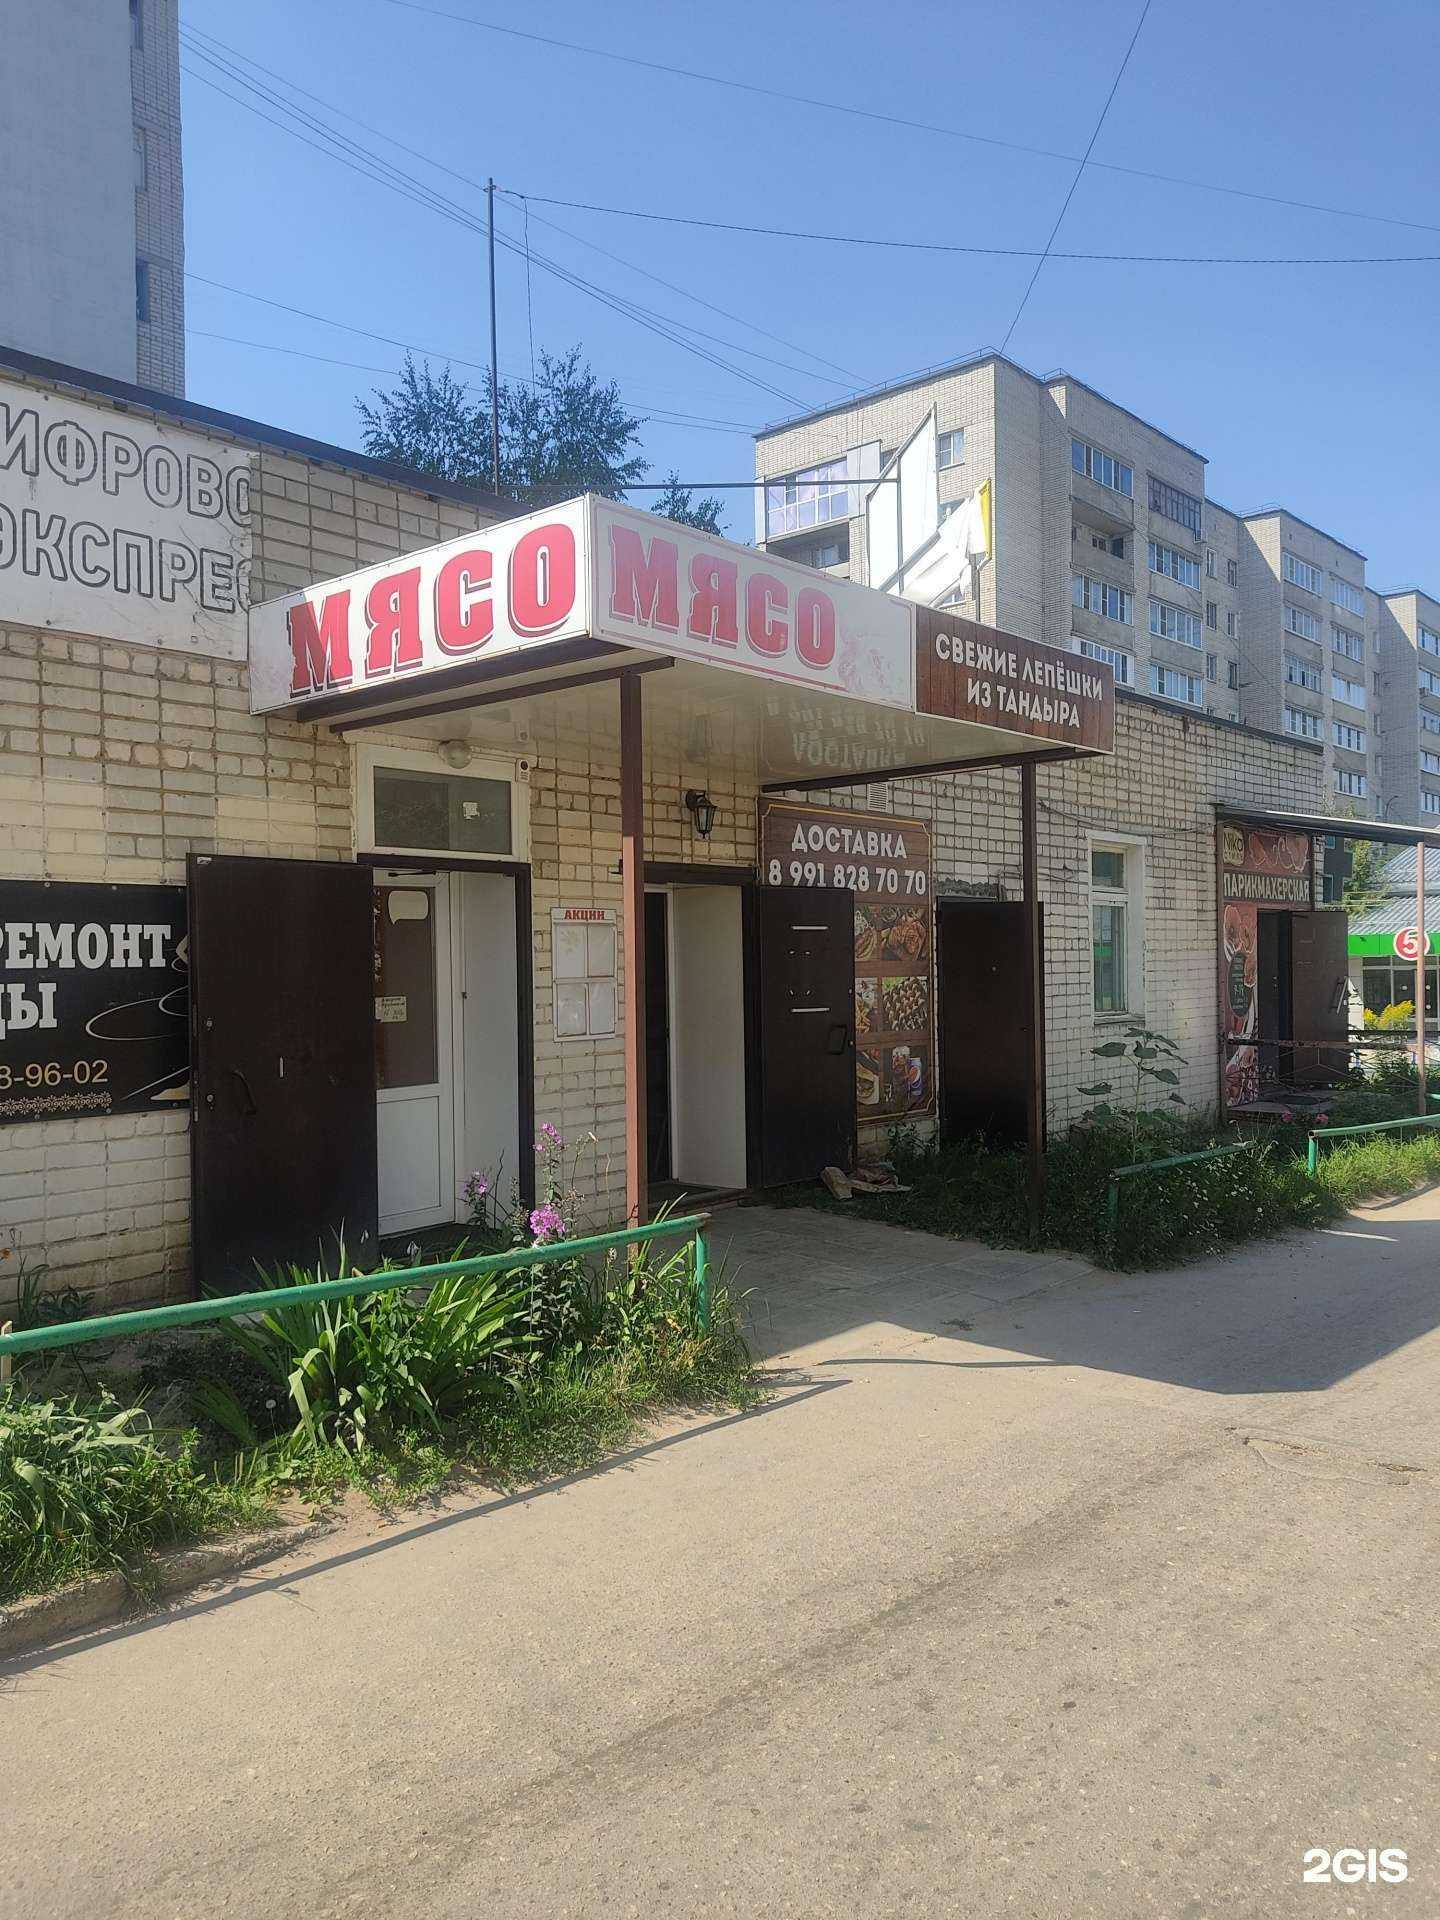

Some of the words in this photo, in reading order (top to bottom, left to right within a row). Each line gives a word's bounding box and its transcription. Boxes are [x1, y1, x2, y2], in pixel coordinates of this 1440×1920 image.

[285, 523, 576, 699] МЯСО
[608, 523, 836, 670] МЯСО
[935, 632, 1018, 680] СВЕЖИЕ
[1022, 656, 1103, 701] ЛЕПЁШКИ
[967, 677, 992, 708] ИЗ
[996, 684, 1080, 729] ТАНДЫРА
[791, 823, 908, 859] ДОСТАВКА
[768, 858, 783, 886] 8
[789, 860, 827, 888] 991
[833, 863, 870, 893] 828
[875, 867, 898, 894] 70
[904, 869, 927, 896] 70
[1223, 872, 1310, 902] ПАРИКМАХЕРСКАЯ
[0, 923, 171, 969] ЕМОНТ
[1401, 928, 1420, 955] 5
[0, 983, 58, 1040] Ы
